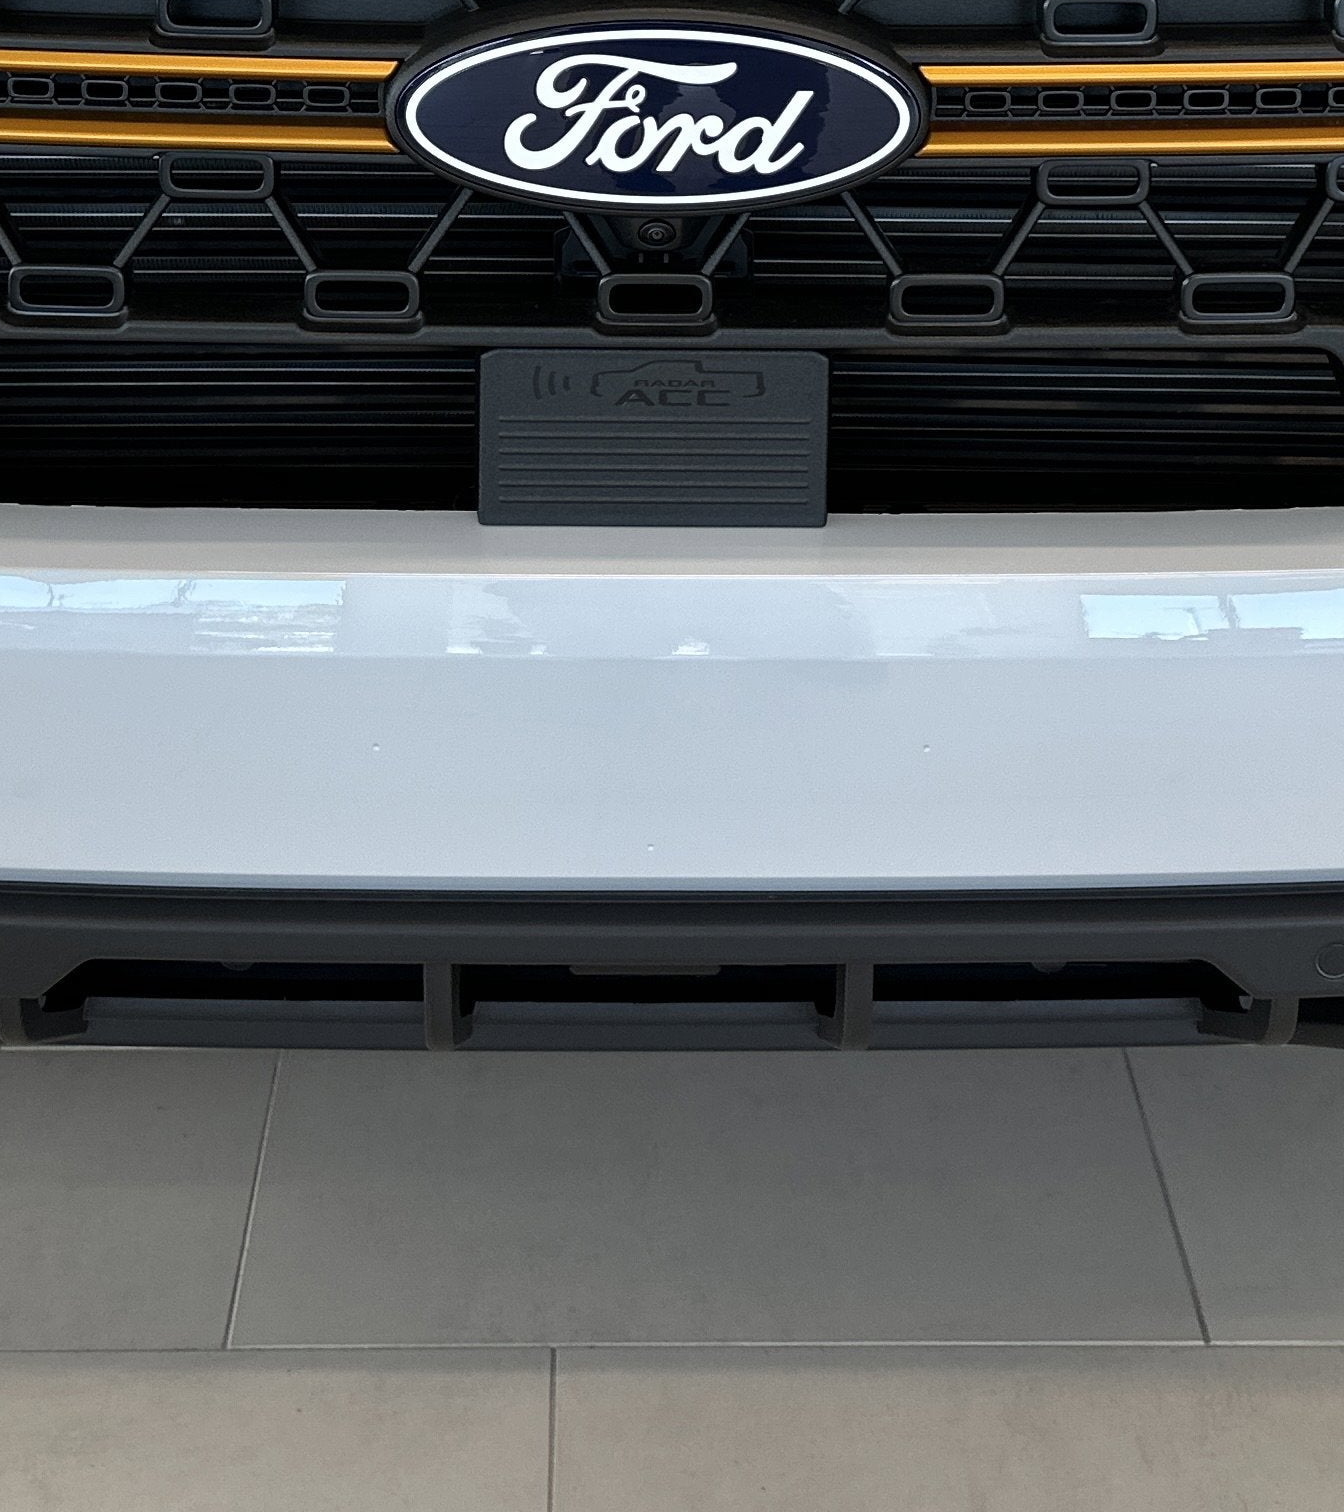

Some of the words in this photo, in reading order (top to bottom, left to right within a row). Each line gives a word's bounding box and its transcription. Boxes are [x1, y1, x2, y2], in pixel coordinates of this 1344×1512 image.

[503, 53, 815, 175] Ford
[633, 379, 715, 388] RADAR
[615, 389, 731, 407] ACC
